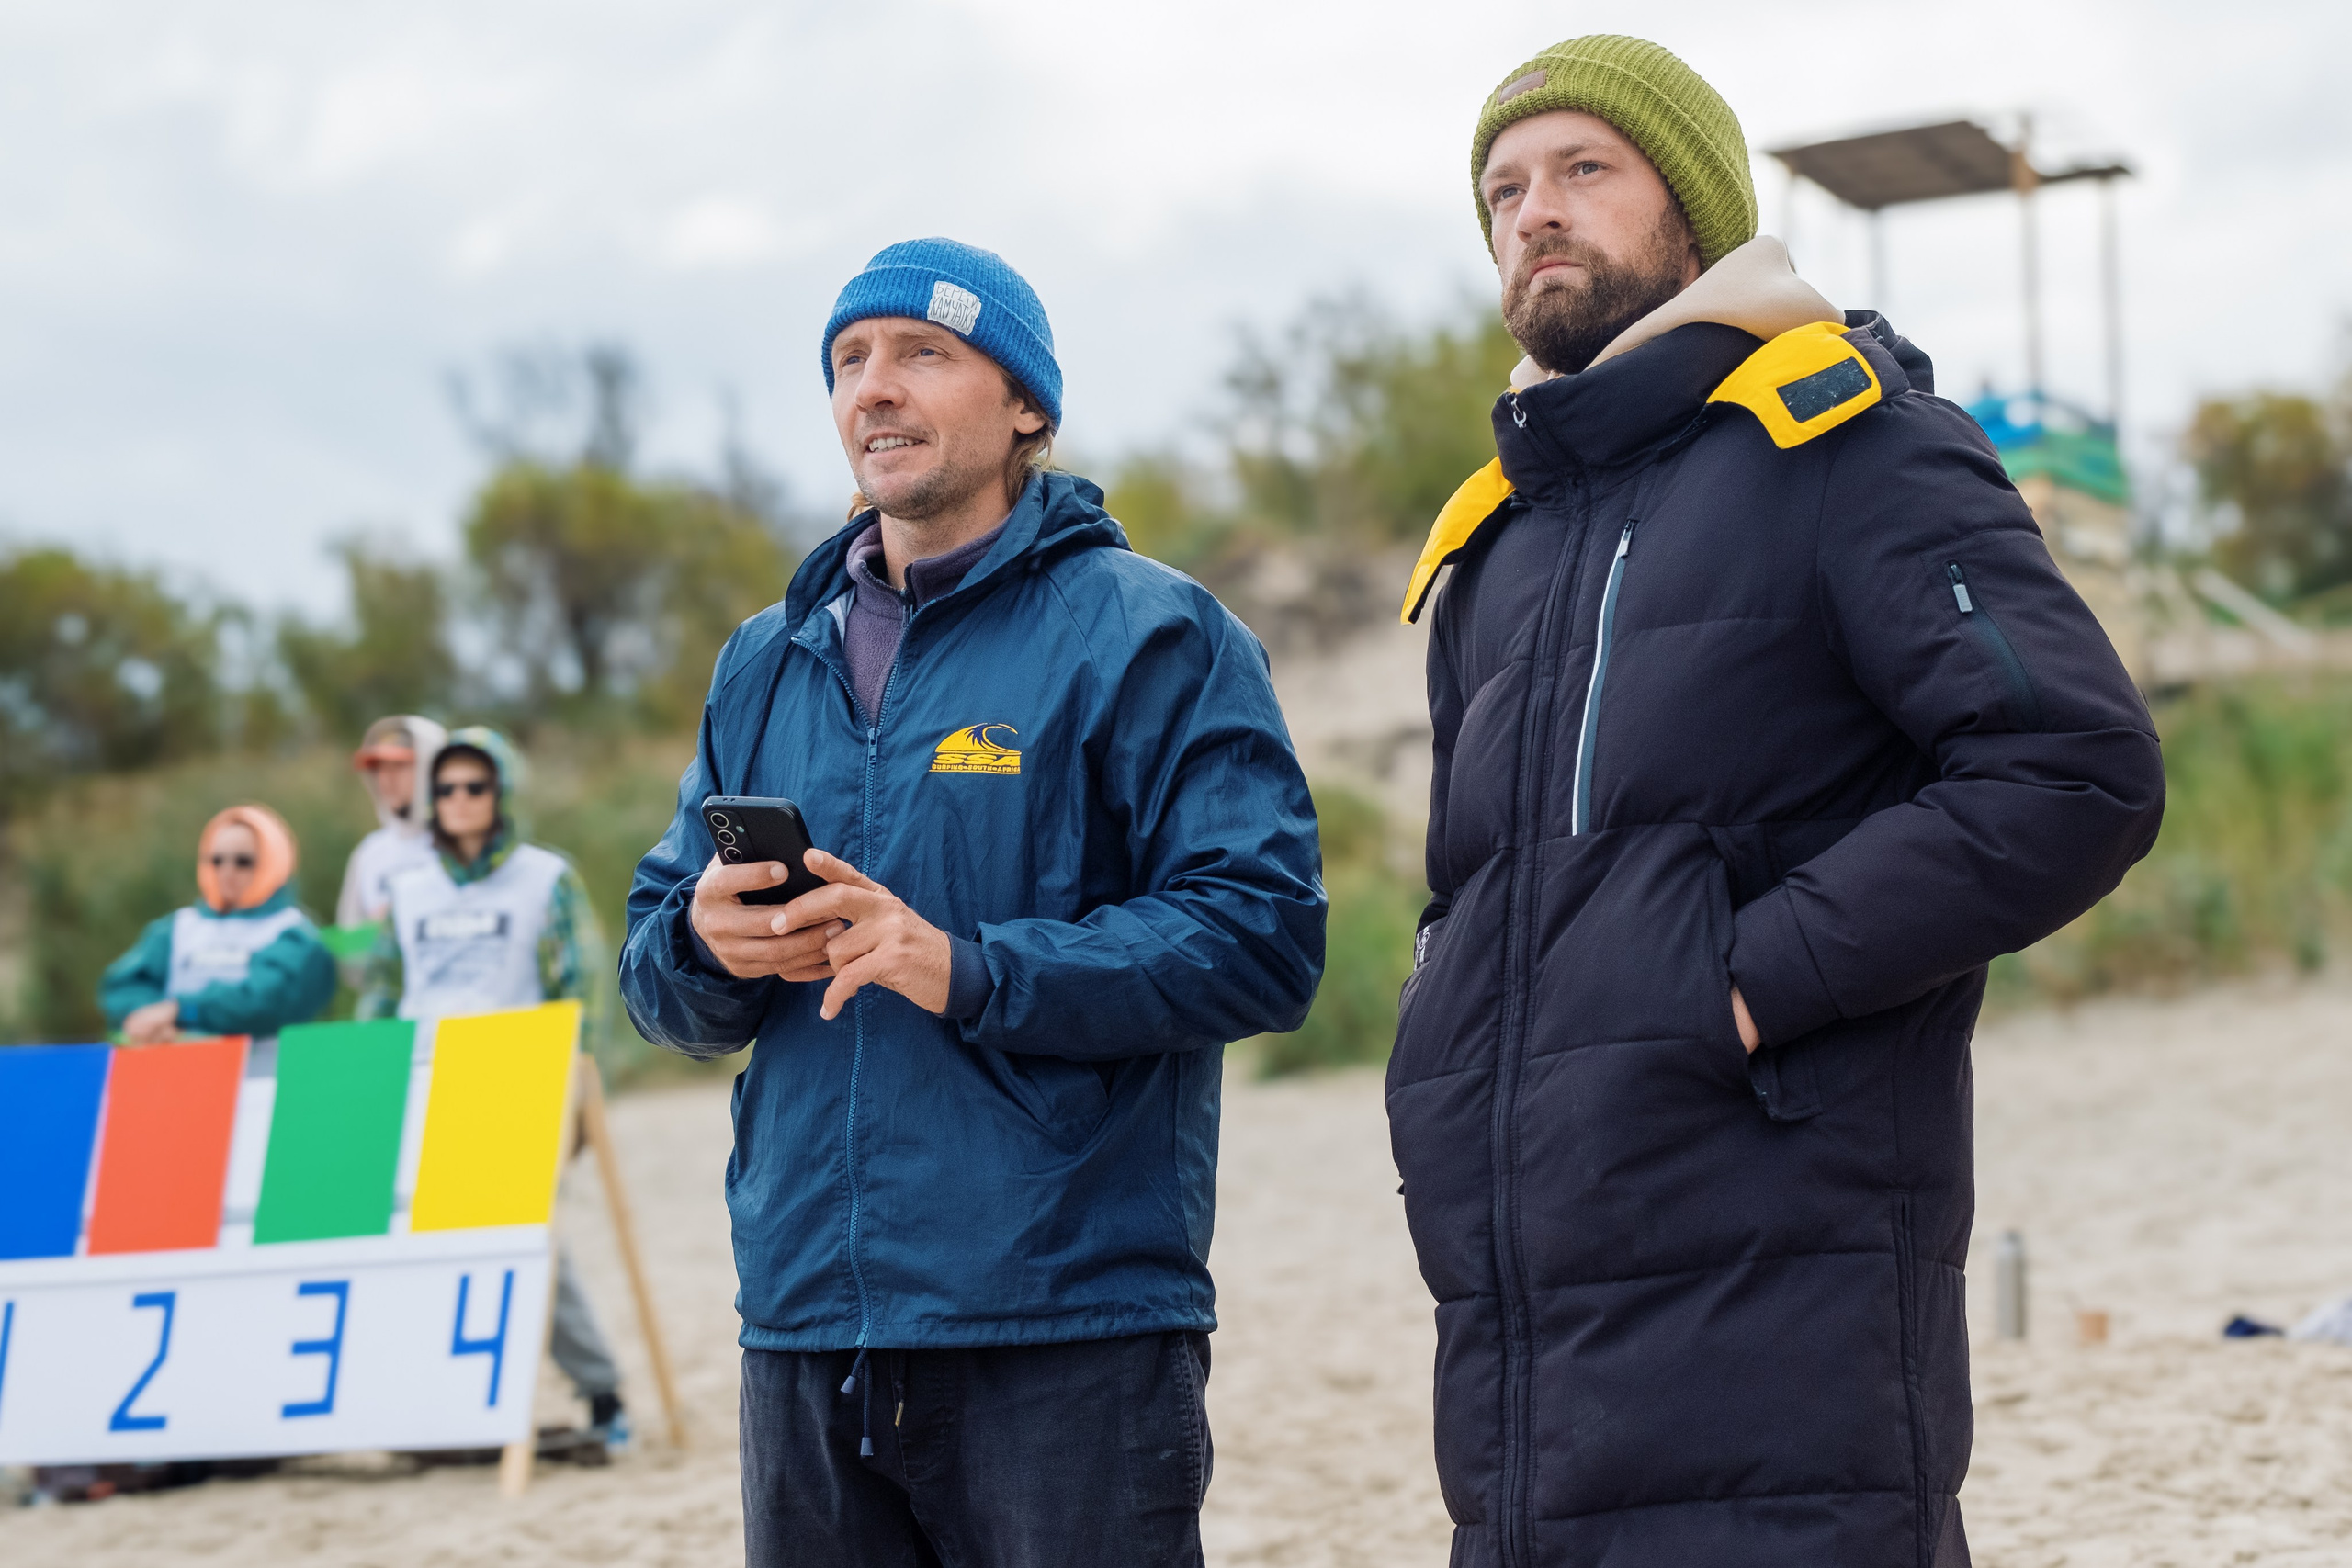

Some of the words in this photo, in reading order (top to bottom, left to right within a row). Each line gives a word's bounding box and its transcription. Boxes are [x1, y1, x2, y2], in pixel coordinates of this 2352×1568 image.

[936, 283, 978, 310] БЕРЕГИ
[930, 295, 976, 330] КАМЧАТКУ
[933, 753, 1020, 766] SSA
[108, 1291, 176, 1432] 2
[281, 1280, 350, 1419] 3
[449, 1269, 514, 1409] 4
